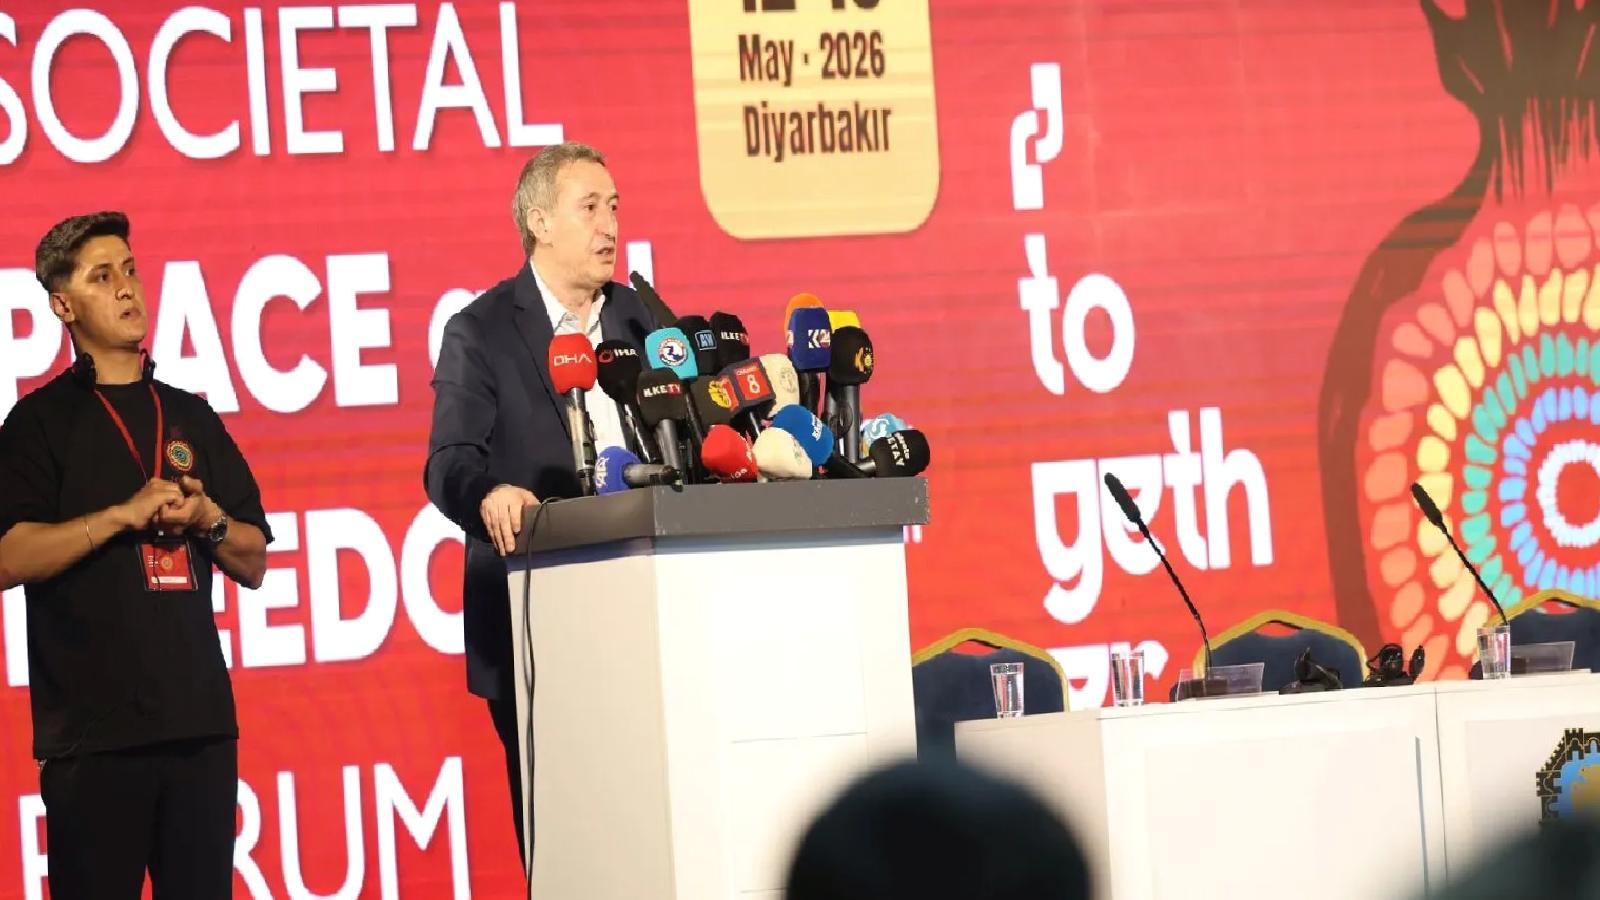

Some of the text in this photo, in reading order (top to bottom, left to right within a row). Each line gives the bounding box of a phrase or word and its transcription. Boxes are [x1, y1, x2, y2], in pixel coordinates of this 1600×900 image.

[738, 29, 886, 87] May 2026
[743, 100, 893, 163] Diyarbakır
[0, 252, 399, 430] PACE
[1017, 234, 1136, 395] to
[553, 353, 592, 366] DHA
[747, 374, 761, 394] 8
